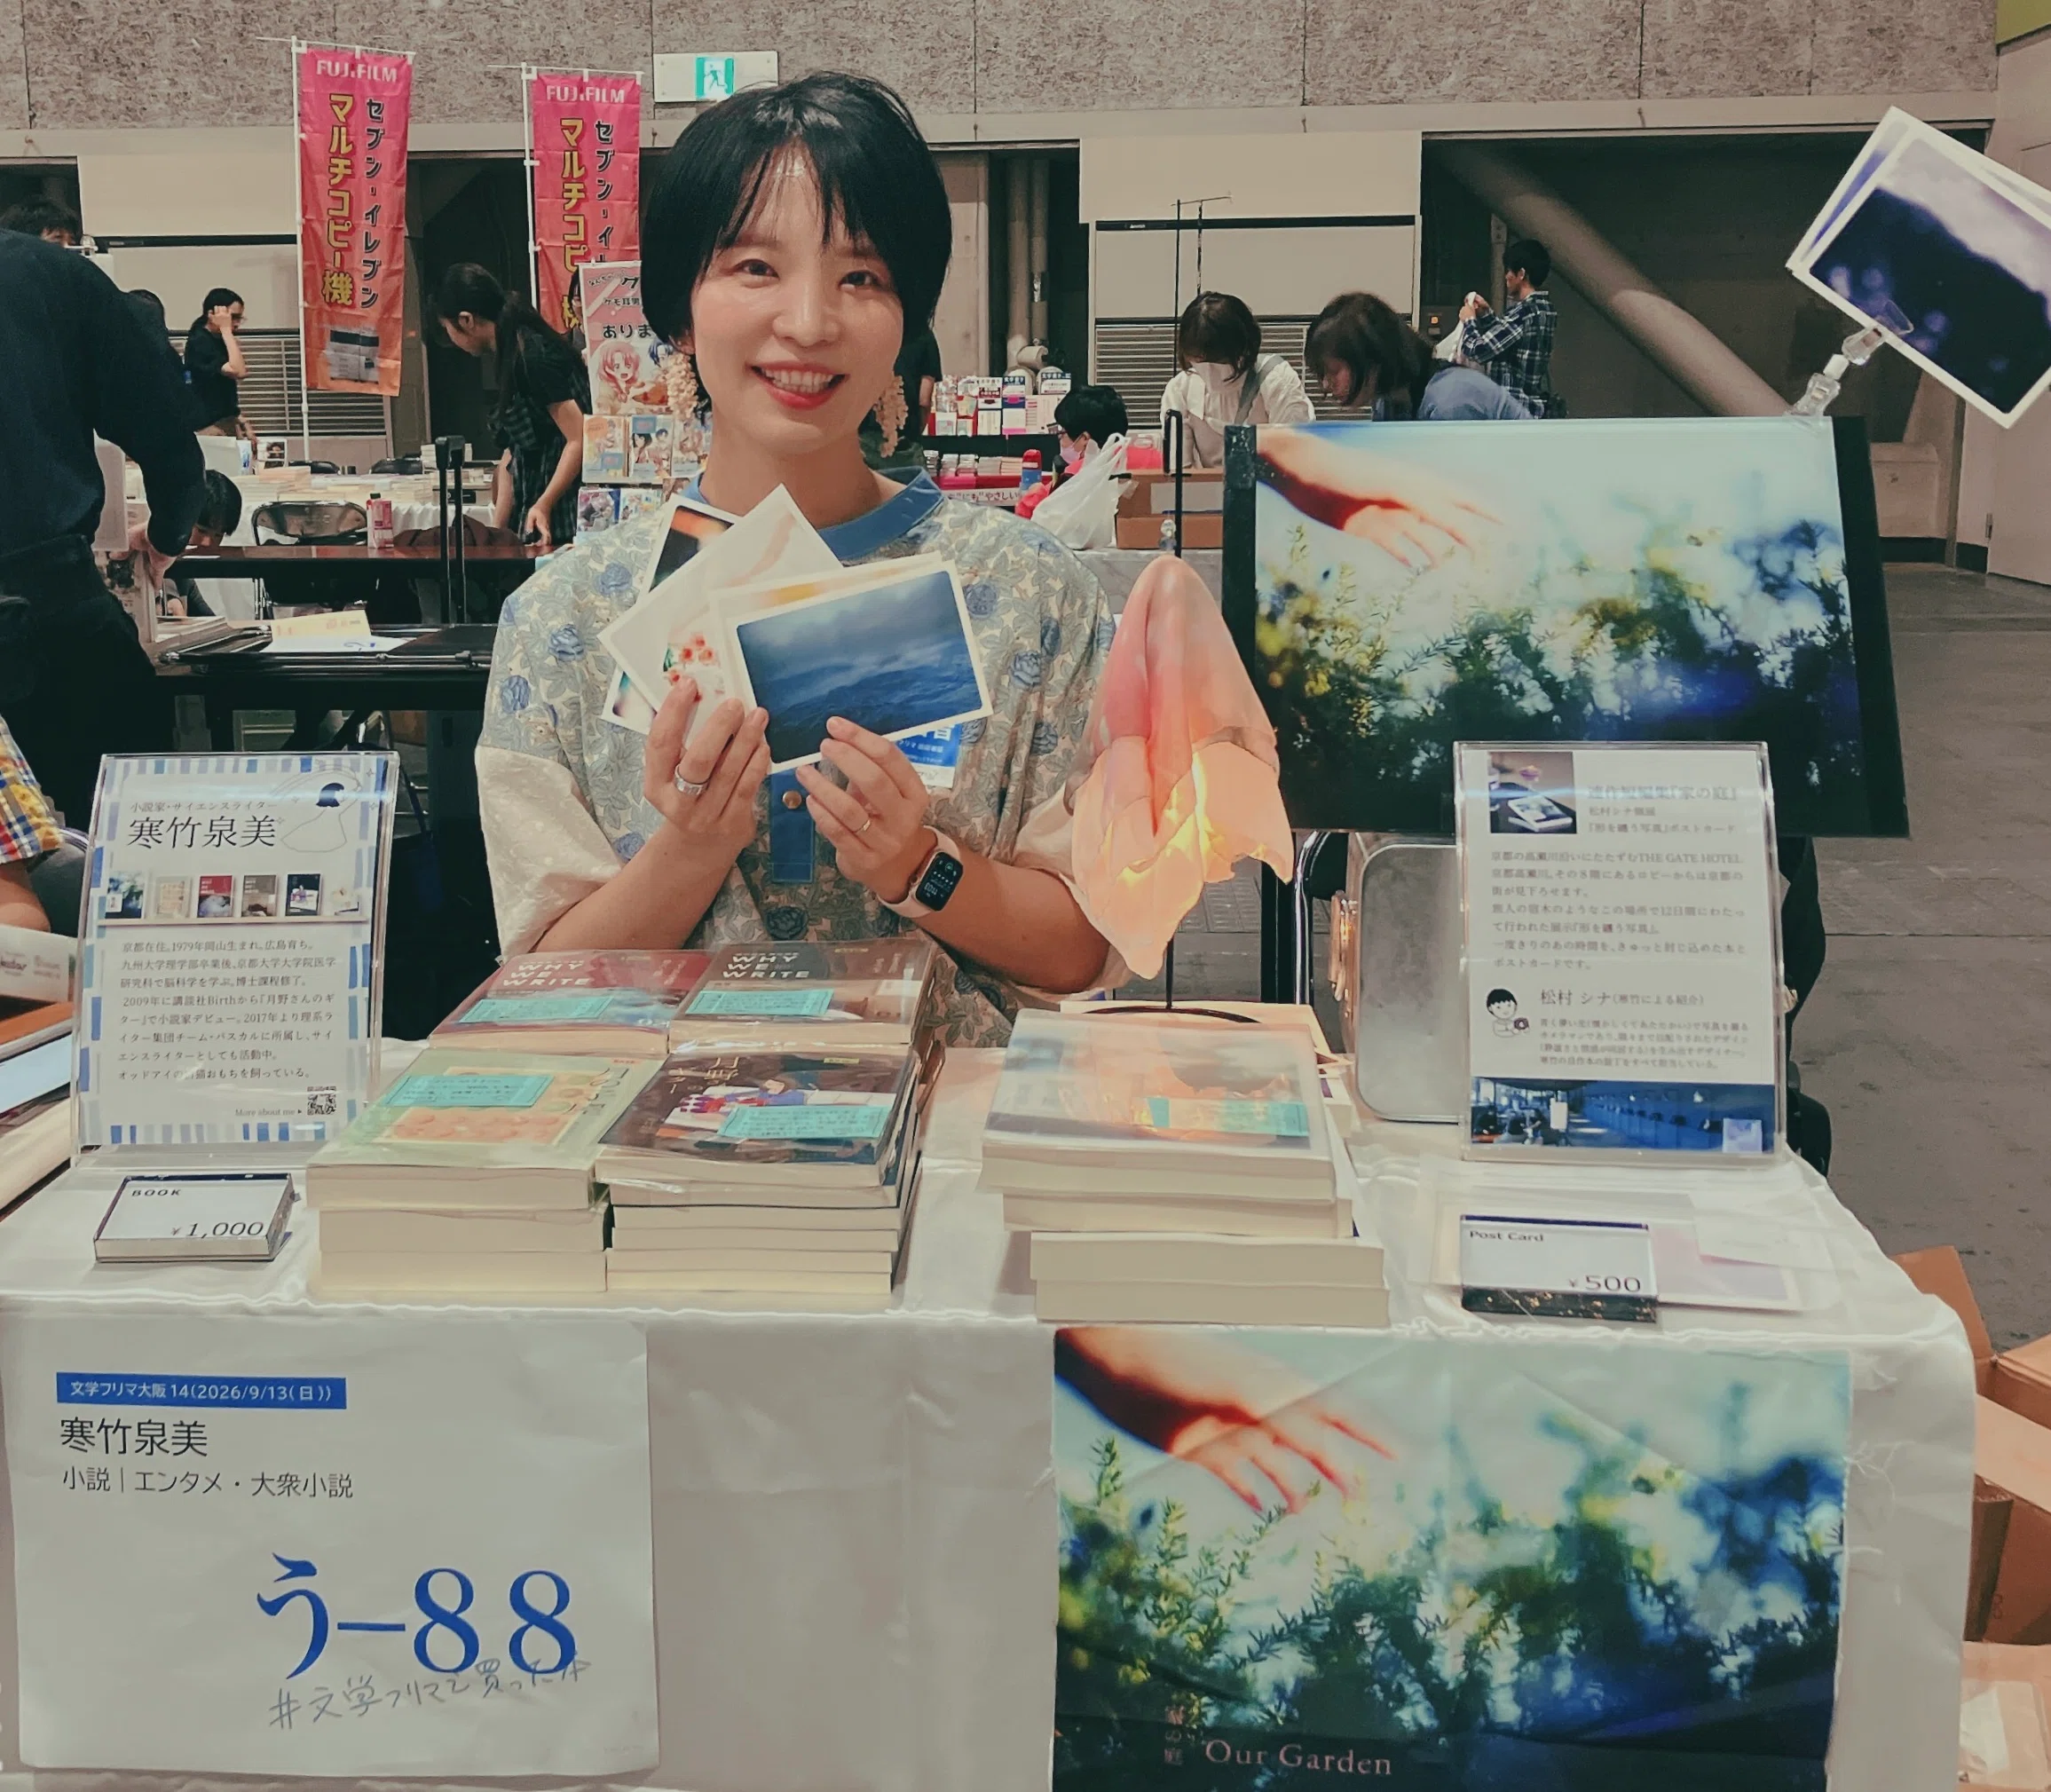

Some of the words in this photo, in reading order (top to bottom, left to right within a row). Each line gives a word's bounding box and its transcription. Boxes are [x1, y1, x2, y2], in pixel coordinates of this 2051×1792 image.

[317, 59, 397, 83] FUJIFILM
[546, 84, 625, 104] FUJIFILM
[321, 93, 354, 306] マルチコピー機
[128, 815, 275, 849] 寒竹泉美
[1666, 853, 1699, 864] GATE
[1701, 853, 1744, 864] HOTEL
[1540, 989, 1573, 1006] 松村
[118, 1066, 310, 1080] オッドアイの猫おもちを飼っている。
[131, 1188, 182, 1197] BOOK
[1469, 1230, 1503, 1241] Post
[1508, 1231, 1544, 1243] Card
[70, 1380, 167, 1400] 文学フリマ大阪
[59, 1416, 209, 1457] 寒竹泉美
[1204, 1739, 1269, 1765] Our
[1278, 1743, 1392, 1775] Garden
